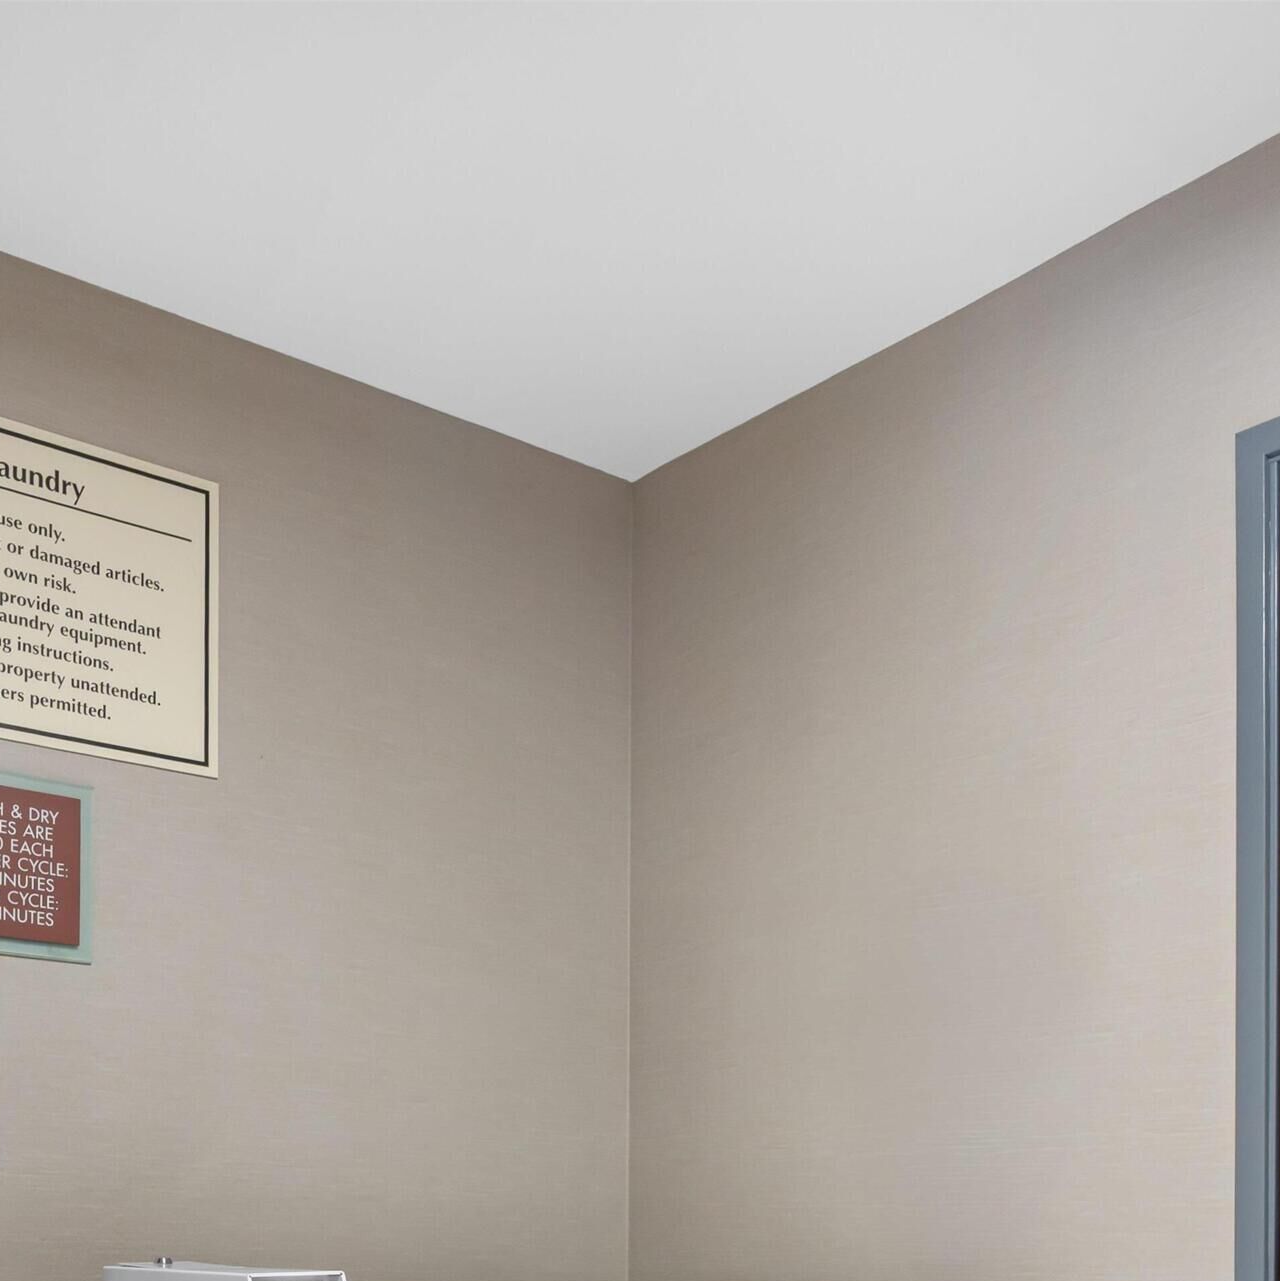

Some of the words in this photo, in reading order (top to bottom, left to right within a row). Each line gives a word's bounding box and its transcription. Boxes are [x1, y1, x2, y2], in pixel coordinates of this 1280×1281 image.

[28, 523, 65, 544] only.
[7, 543, 24, 555] or
[30, 545, 100, 575] damaged
[106, 569, 164, 592] articles.
[4, 568, 37, 584] own
[44, 574, 76, 594] risk.
[0, 592, 60, 614] provide
[65, 608, 83, 620] an
[89, 613, 160, 639] attendant
[18, 636, 113, 671] instructions.
[60, 626, 146, 655] equipment.
[71, 678, 160, 706] unattended.
[30, 694, 111, 720] permitted.
[11, 804, 22, 819] &
[29, 808, 59, 824] DRY
[23, 824, 53, 841] ARE
[10, 839, 53, 858] EACH
[17, 858, 69, 878] CYCLE:
[8, 891, 59, 911] CYCLE:
